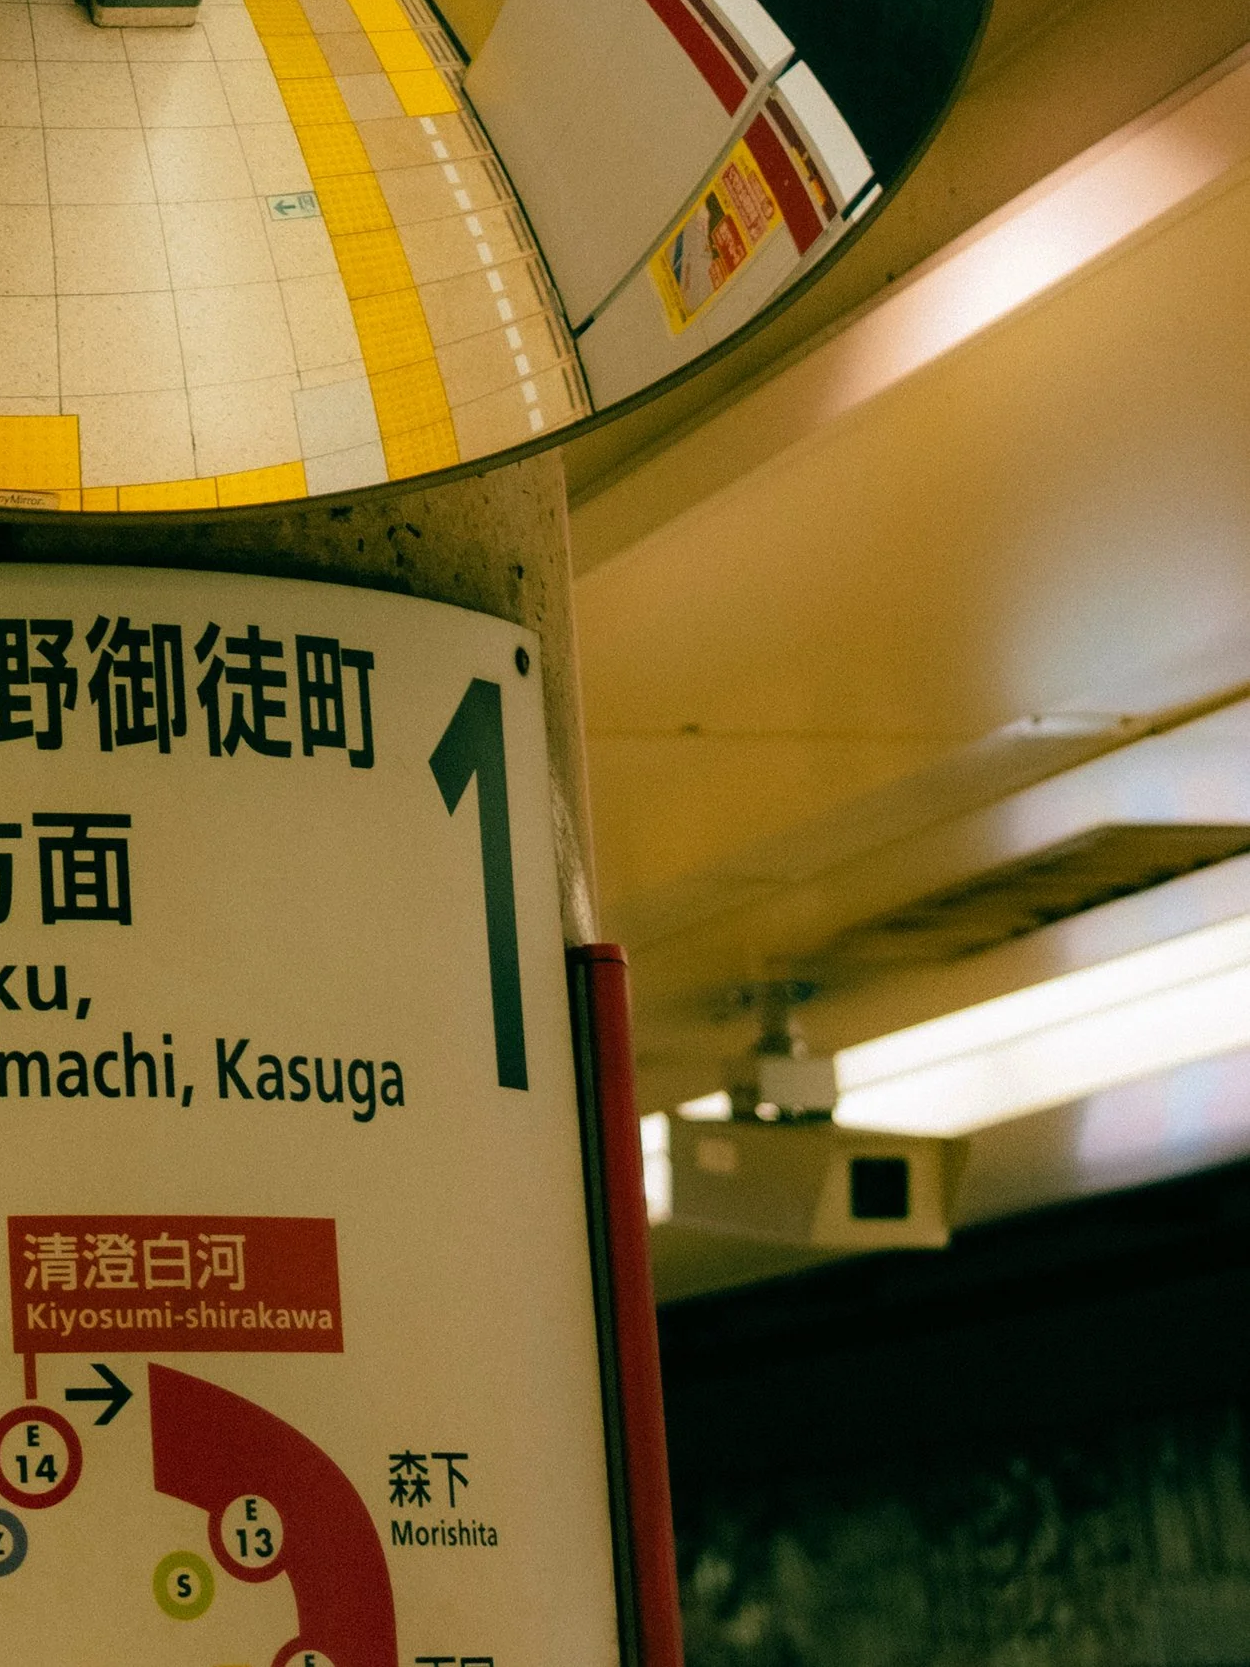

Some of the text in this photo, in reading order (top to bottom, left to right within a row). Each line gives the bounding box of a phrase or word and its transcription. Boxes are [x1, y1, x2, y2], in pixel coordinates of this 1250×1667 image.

[428, 676, 529, 1091] 1
[215, 1037, 405, 1124] Kasuga
[23, 1231, 247, 1291] 清澄白河
[26, 1300, 334, 1337] Kiyosumi-shirakawa
[26, 1424, 40, 1448] E
[15, 1454, 58, 1484] 14
[388, 1449, 469, 1508] 森下
[245, 1498, 258, 1522] E
[235, 1527, 275, 1558] 13
[390, 1518, 499, 1547] Morishita
[176, 1573, 192, 1599] S
